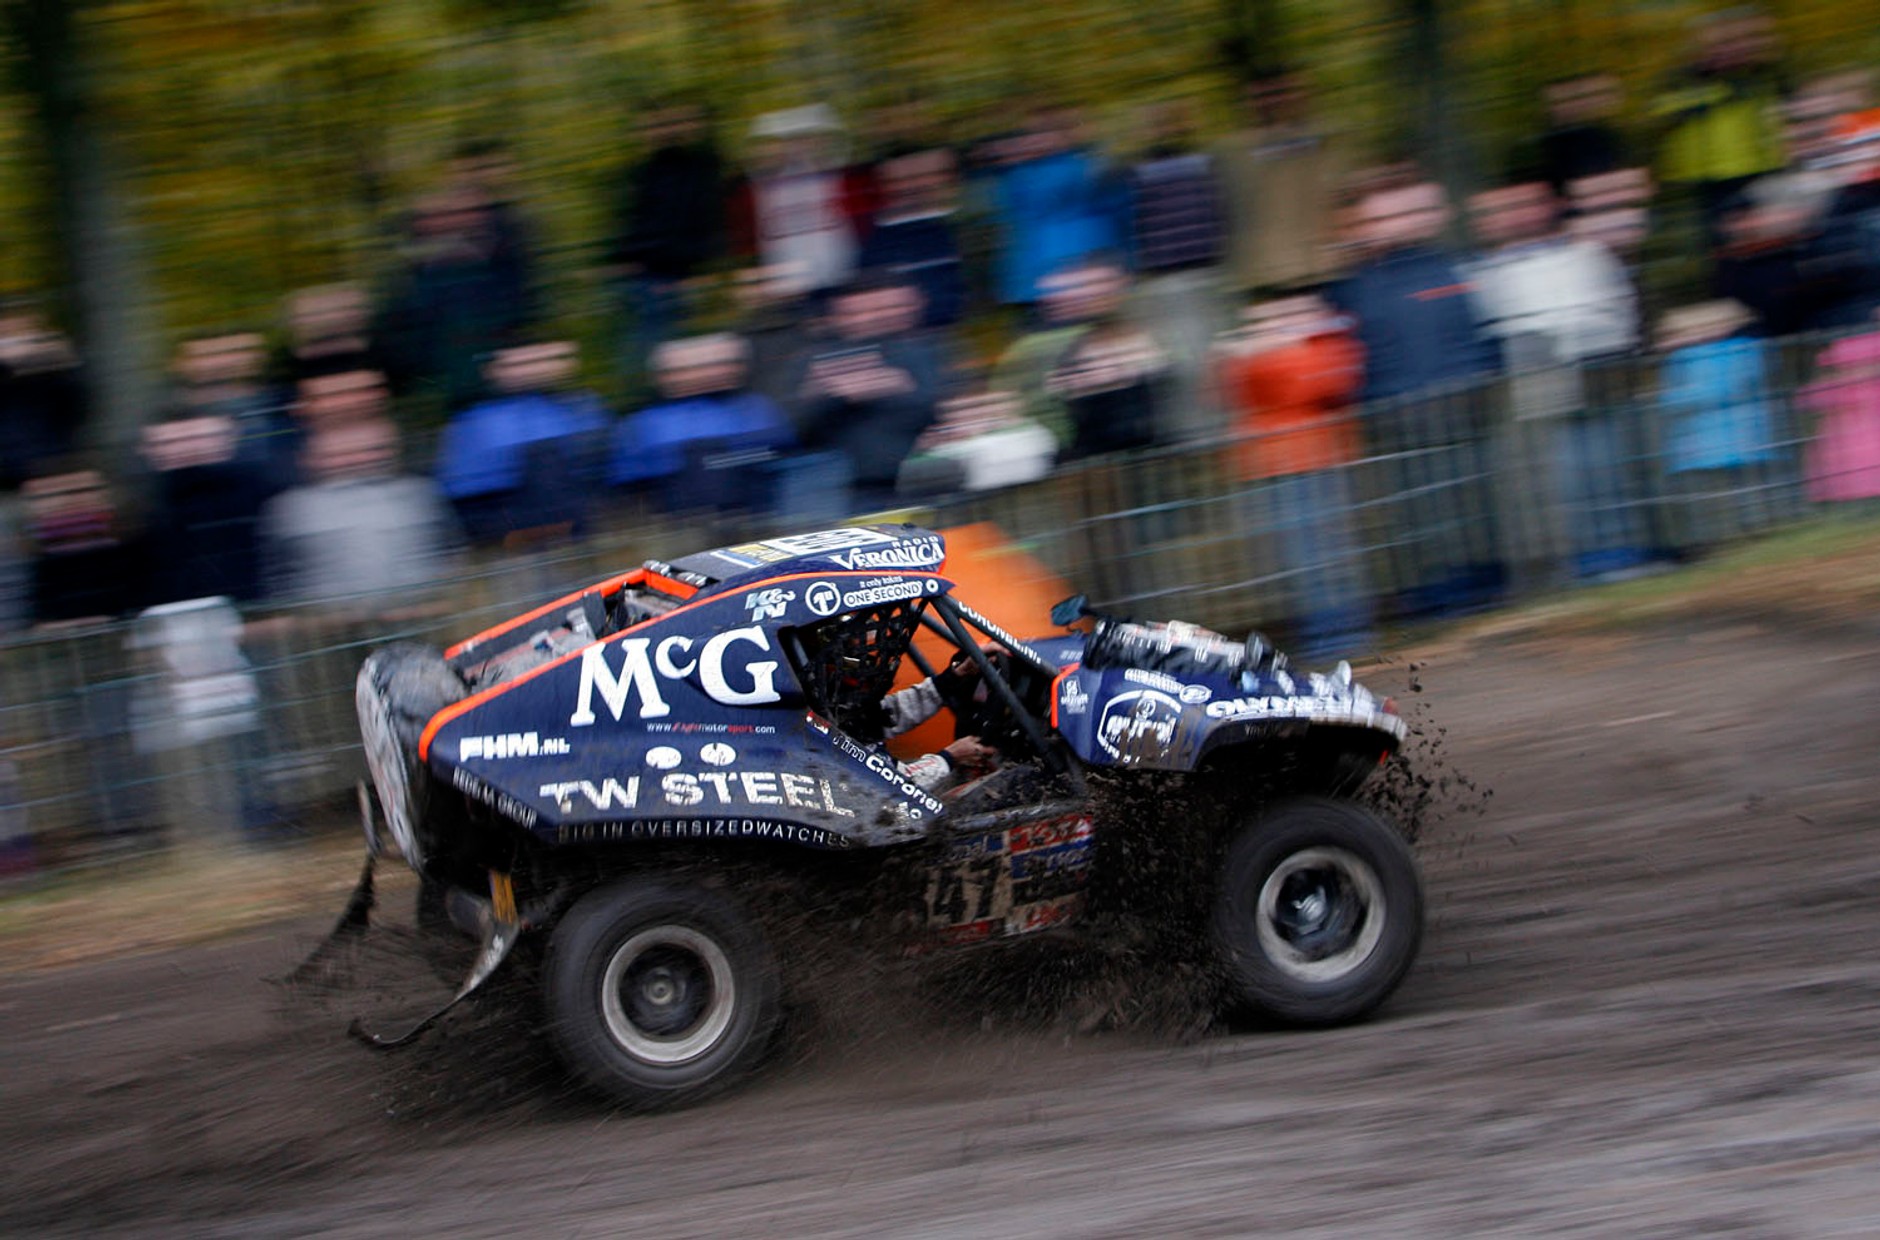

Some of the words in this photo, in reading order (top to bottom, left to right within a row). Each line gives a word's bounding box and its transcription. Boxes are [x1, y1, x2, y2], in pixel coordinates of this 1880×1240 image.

[892, 535, 939, 549] RADIO
[829, 543, 945, 570] VERONICA
[845, 589, 872, 606] ONE
[570, 625, 781, 727] McG
[539, 776, 640, 814] TW
[661, 772, 855, 818] STEEL
